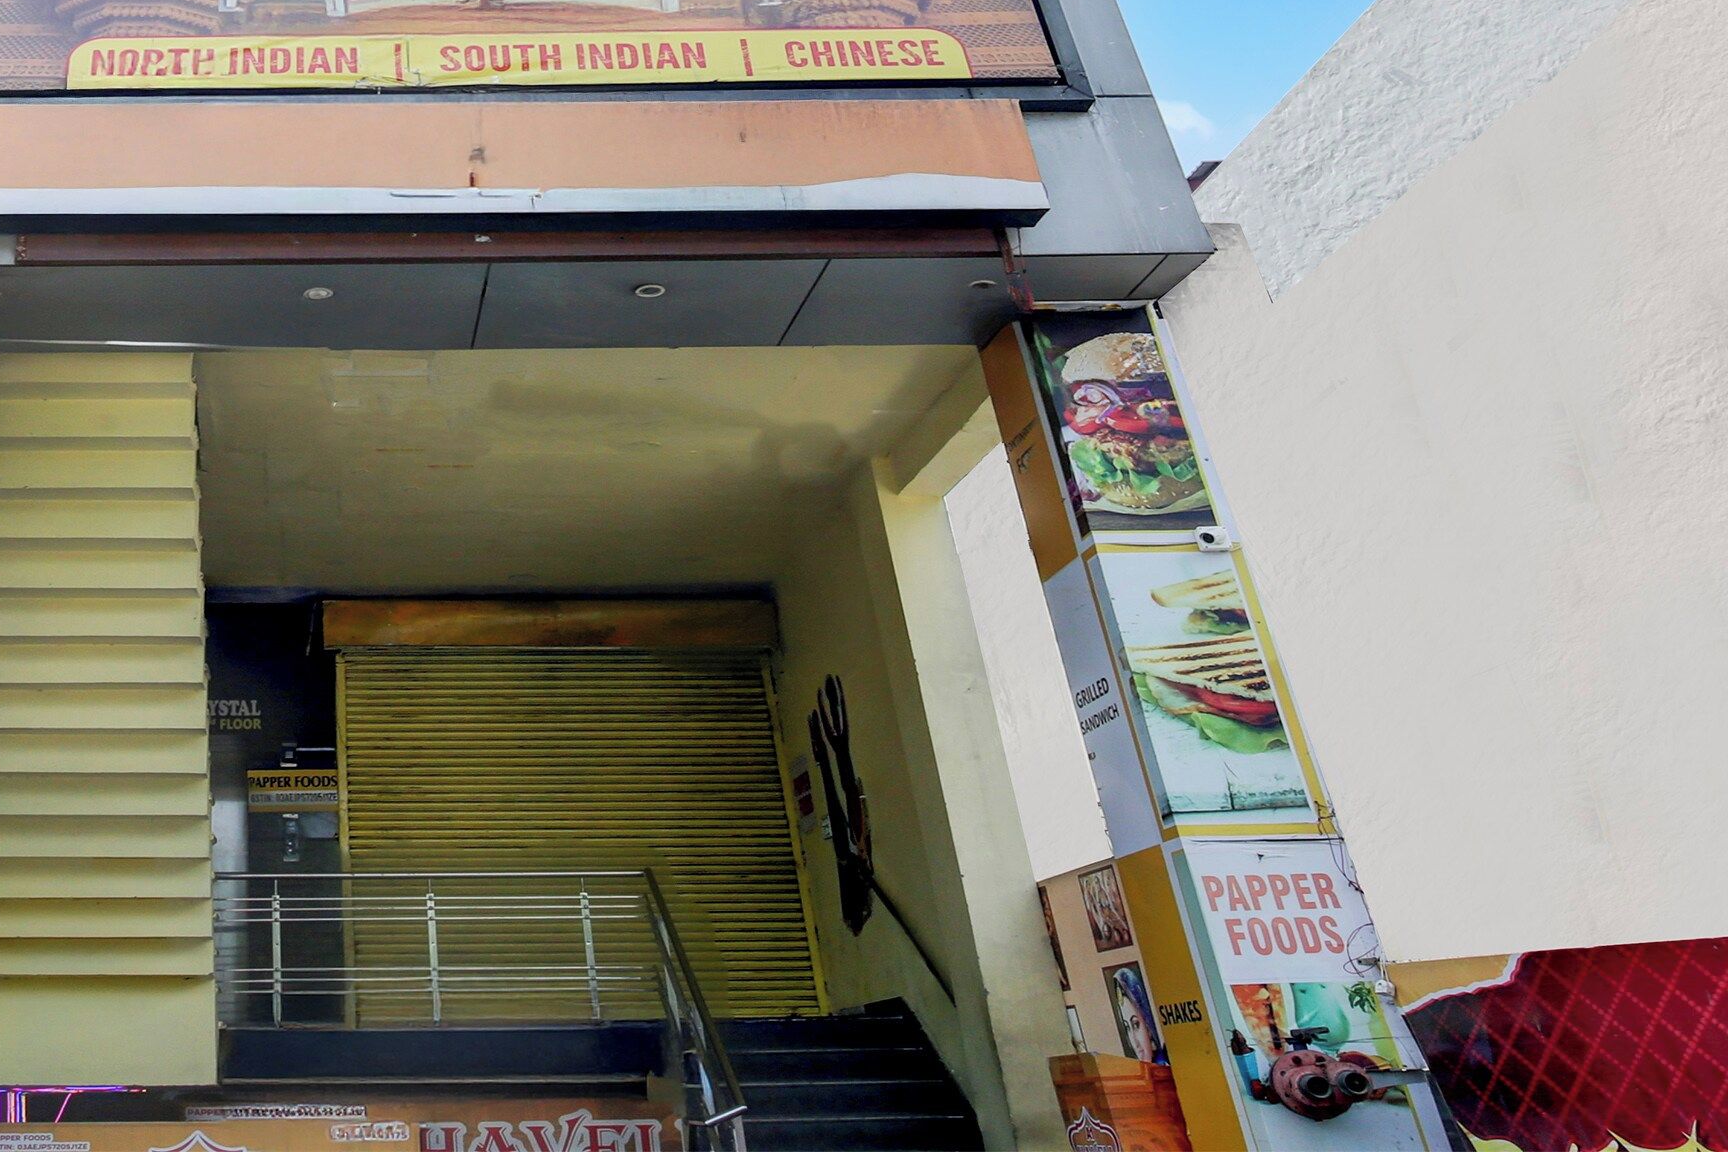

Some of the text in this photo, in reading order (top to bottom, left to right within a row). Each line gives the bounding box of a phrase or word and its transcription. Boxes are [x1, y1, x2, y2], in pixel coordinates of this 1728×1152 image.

[228, 46, 359, 76] INDIAN
[438, 41, 709, 72] SOUTH INDIAN
[783, 38, 947, 68] CHINESE
[1074, 676, 1110, 709] GRILLED
[219, 718, 262, 730] FLOOR
[1080, 702, 1121, 735] SANDWICH
[294, 775, 338, 787] FOODS
[1200, 872, 1343, 912] PAPPER
[1223, 915, 1346, 957] FOODS
[1159, 1000, 1203, 1027] SHAKES
[23, 1134, 52, 1142] FOODS
